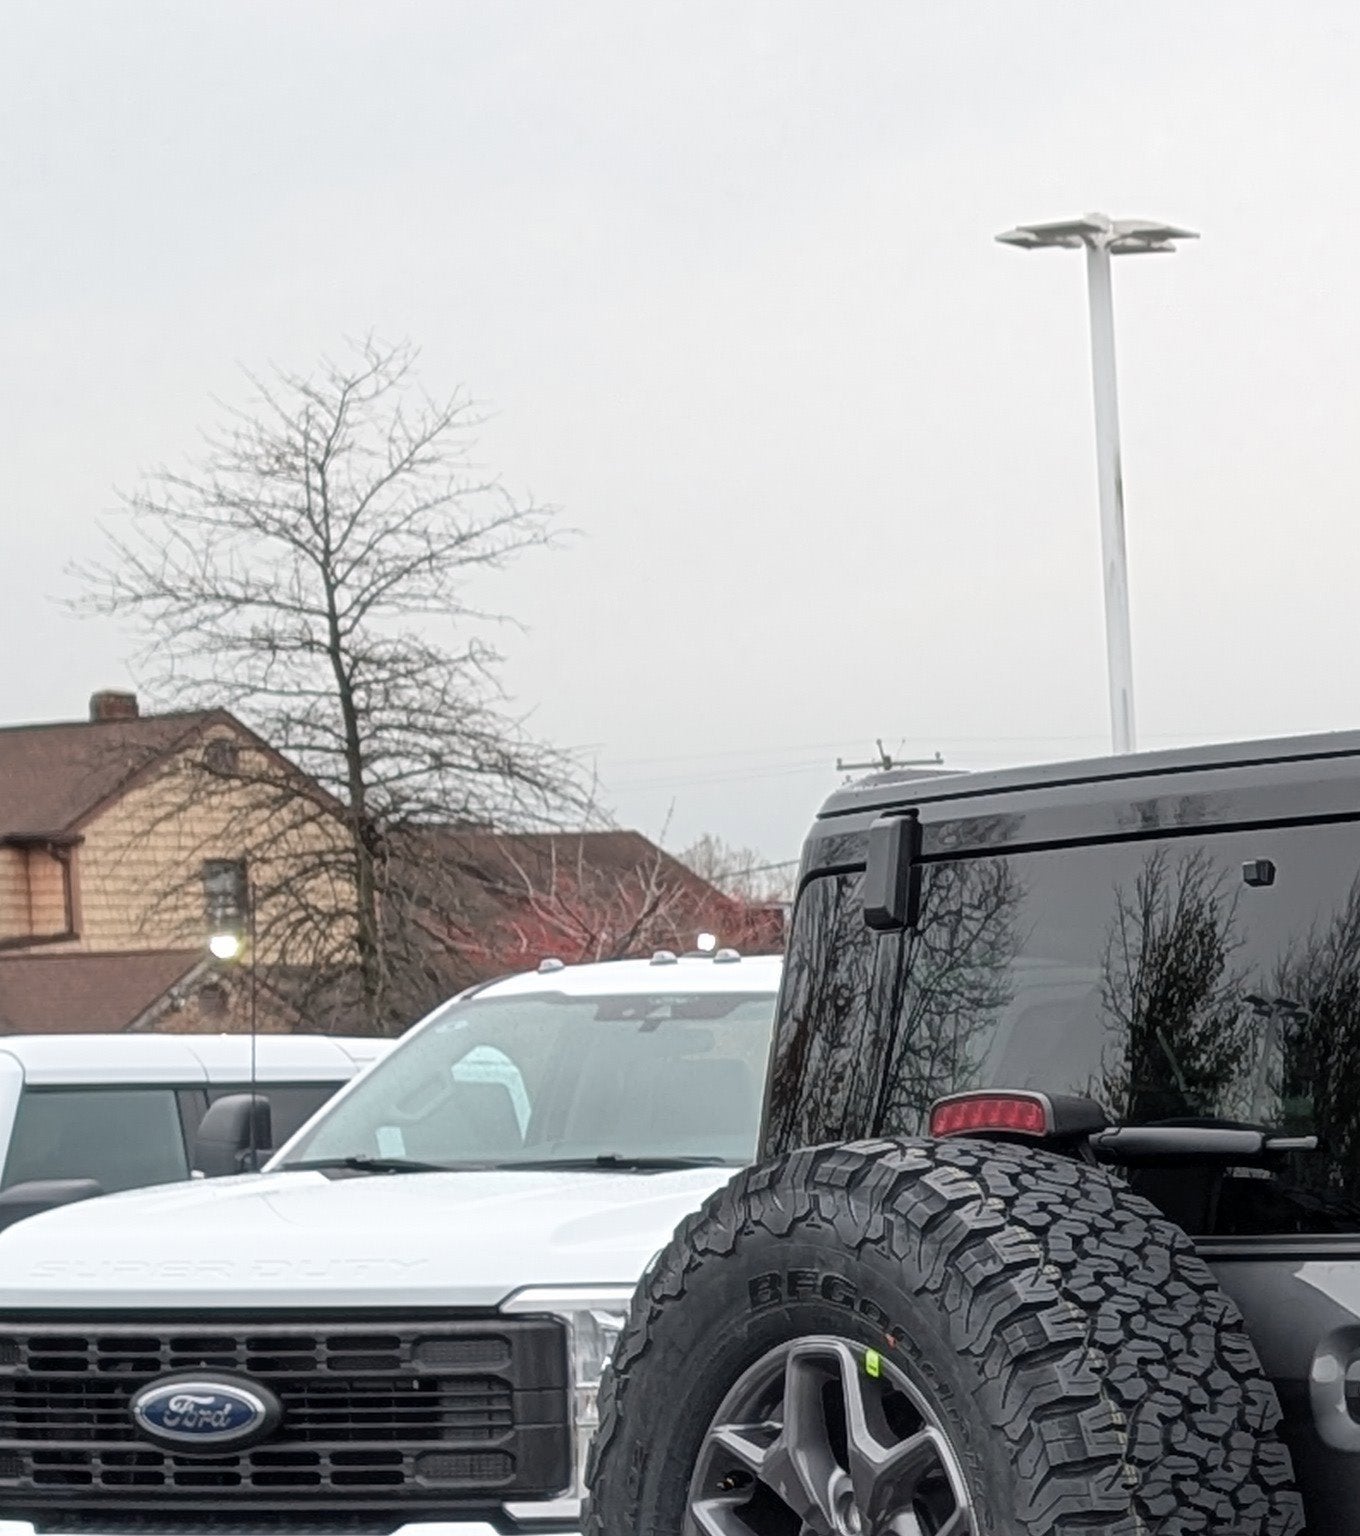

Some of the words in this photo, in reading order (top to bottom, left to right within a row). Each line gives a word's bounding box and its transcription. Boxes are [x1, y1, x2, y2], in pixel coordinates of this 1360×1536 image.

[28, 1259, 236, 1279] SUPER
[249, 1257, 429, 1279] DUTY
[163, 1394, 232, 1429] Ford
